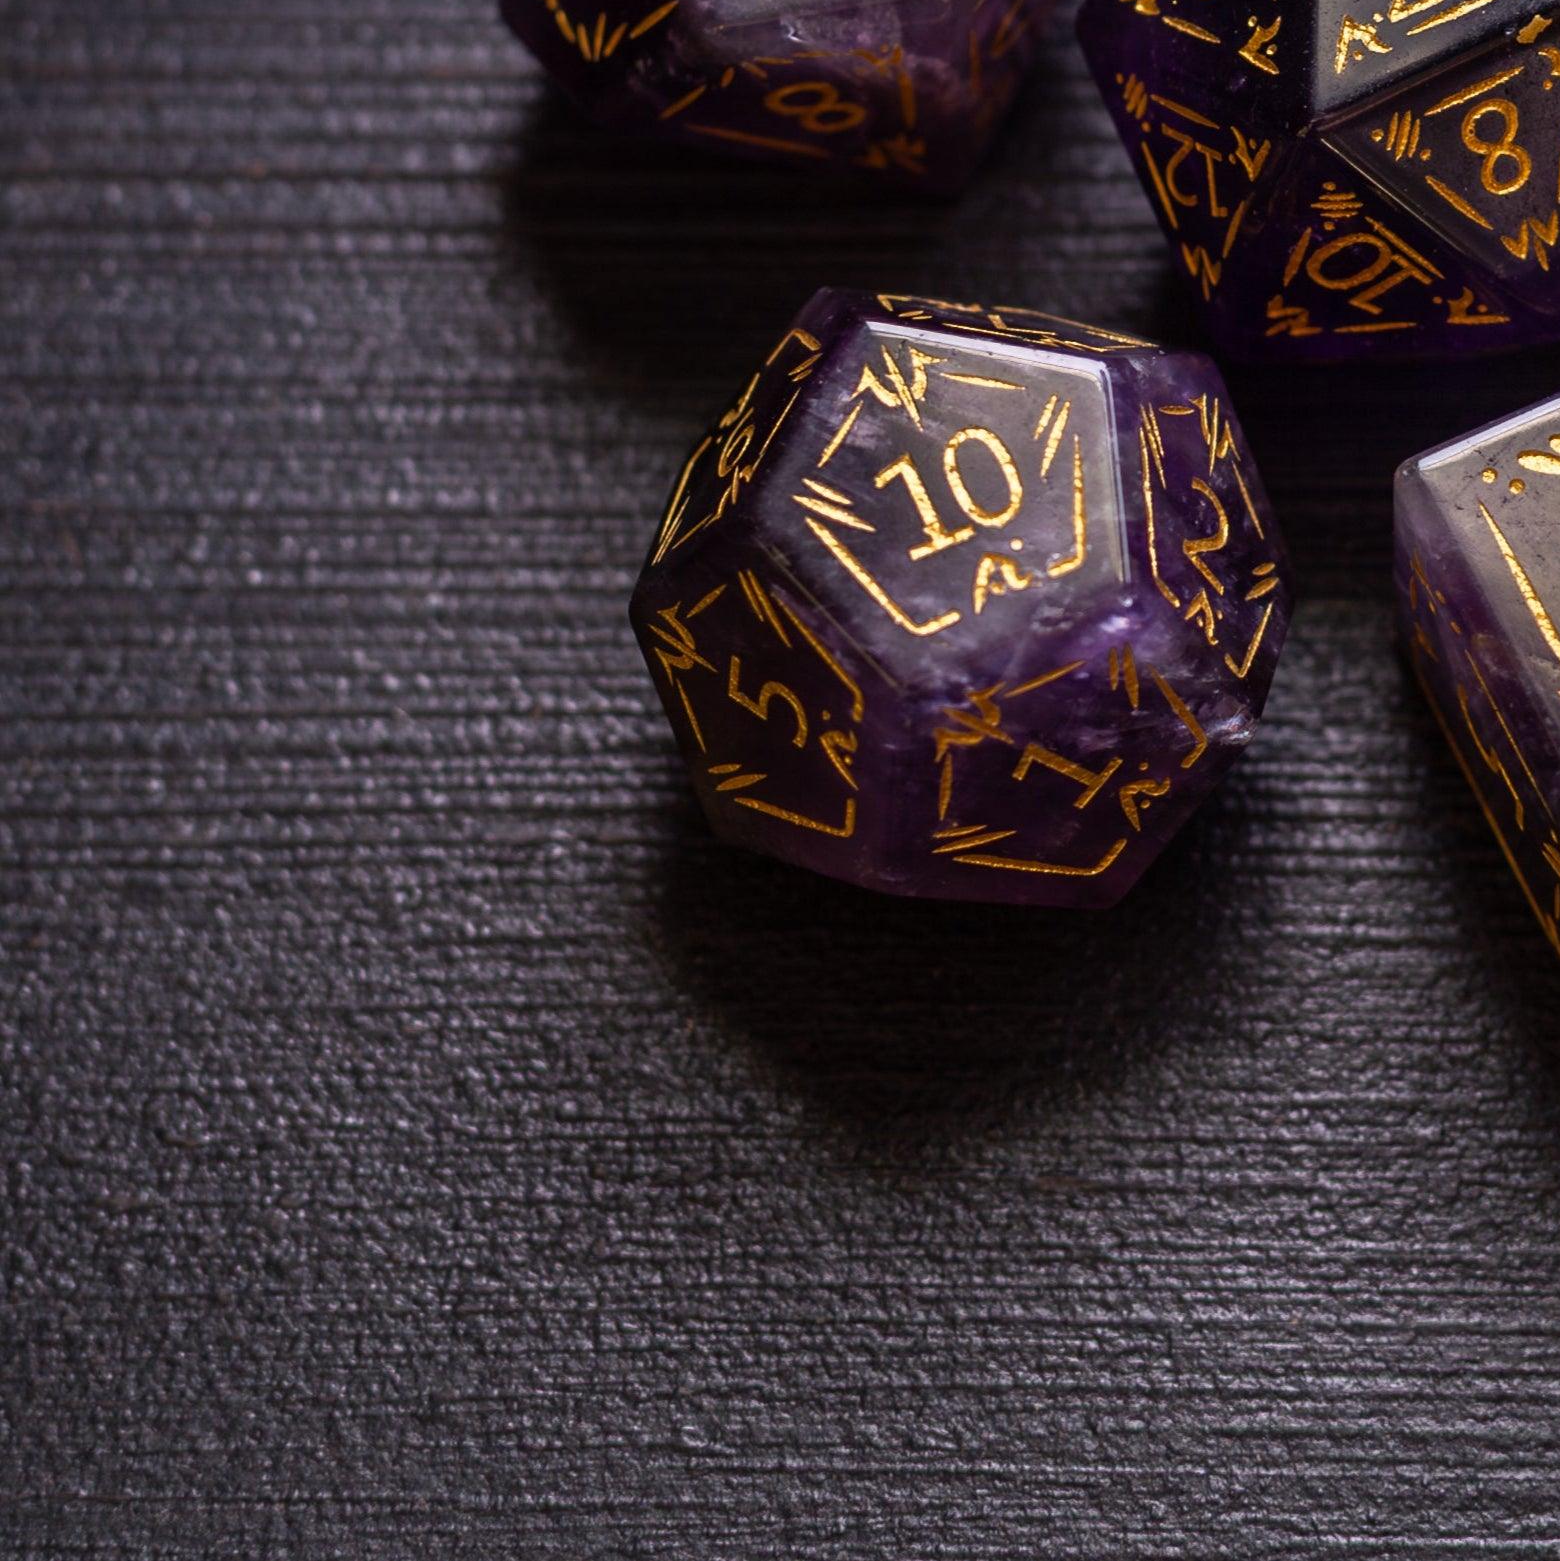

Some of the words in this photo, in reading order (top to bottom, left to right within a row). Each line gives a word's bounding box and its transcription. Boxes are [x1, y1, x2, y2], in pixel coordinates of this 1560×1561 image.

[764, 81, 866, 131] 8
[1462, 98, 1531, 194] 8
[1161, 122, 1229, 218] 12
[1306, 233, 1432, 315] 10
[874, 425, 1024, 561] 10
[1182, 477, 1229, 595] 2
[728, 655, 808, 748] 5
[1011, 742, 1123, 810] 1
